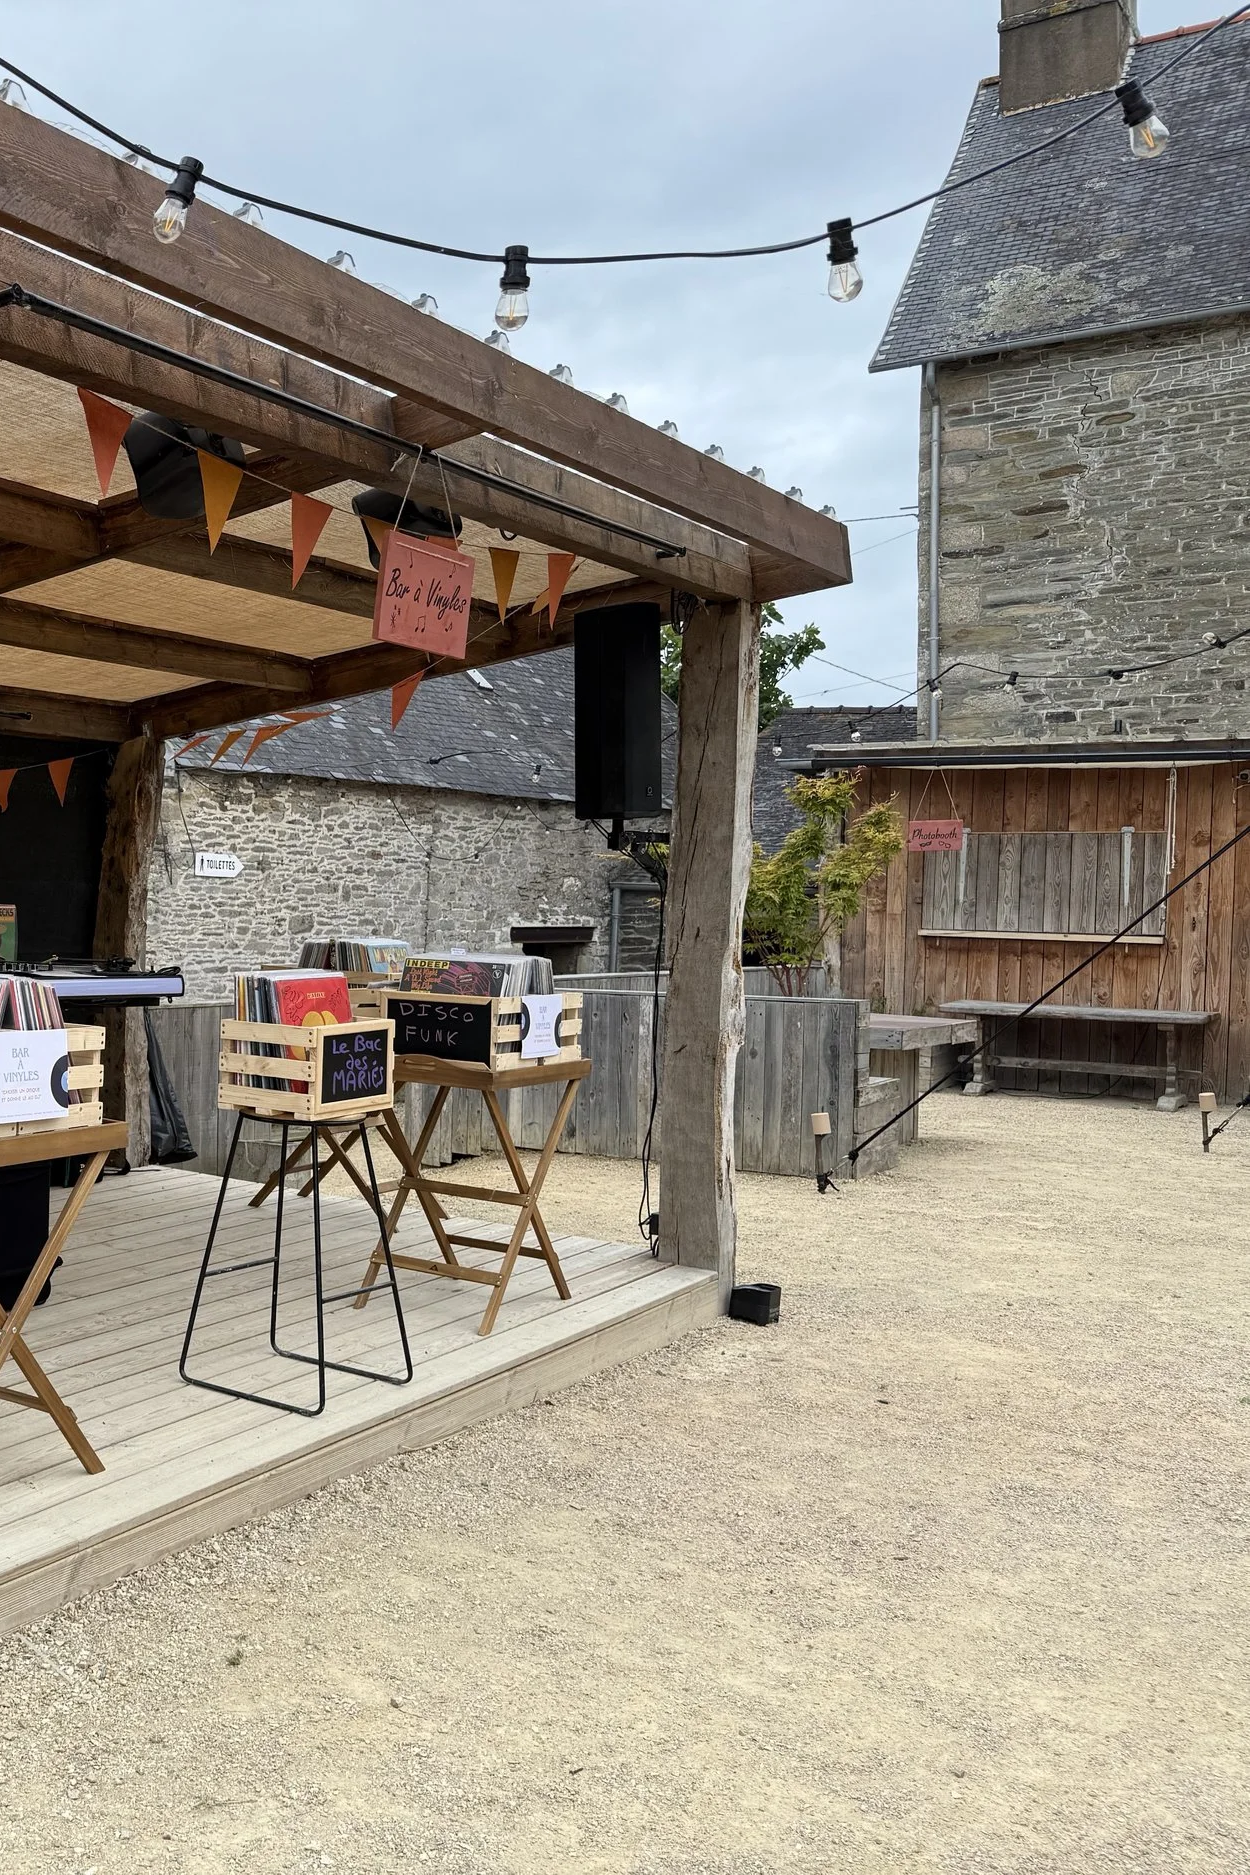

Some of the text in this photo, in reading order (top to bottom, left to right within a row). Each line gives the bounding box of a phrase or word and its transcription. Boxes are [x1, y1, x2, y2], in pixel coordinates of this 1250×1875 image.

[386, 568, 467, 619] Bar à Vinyles
[912, 828, 957, 839] Photobooth
[207, 860, 235, 870] TOILETTES
[406, 959, 449, 969] INDEEP
[399, 1002, 474, 1022] DISCO
[332, 1034, 382, 1054] Le Bac
[405, 1025, 459, 1046] FUNK
[11, 1047, 29, 1058] BAR
[345, 1053, 368, 1070] des
[3, 1070, 40, 1083] VINYLES
[332, 1060, 384, 1095] MARIÉS
